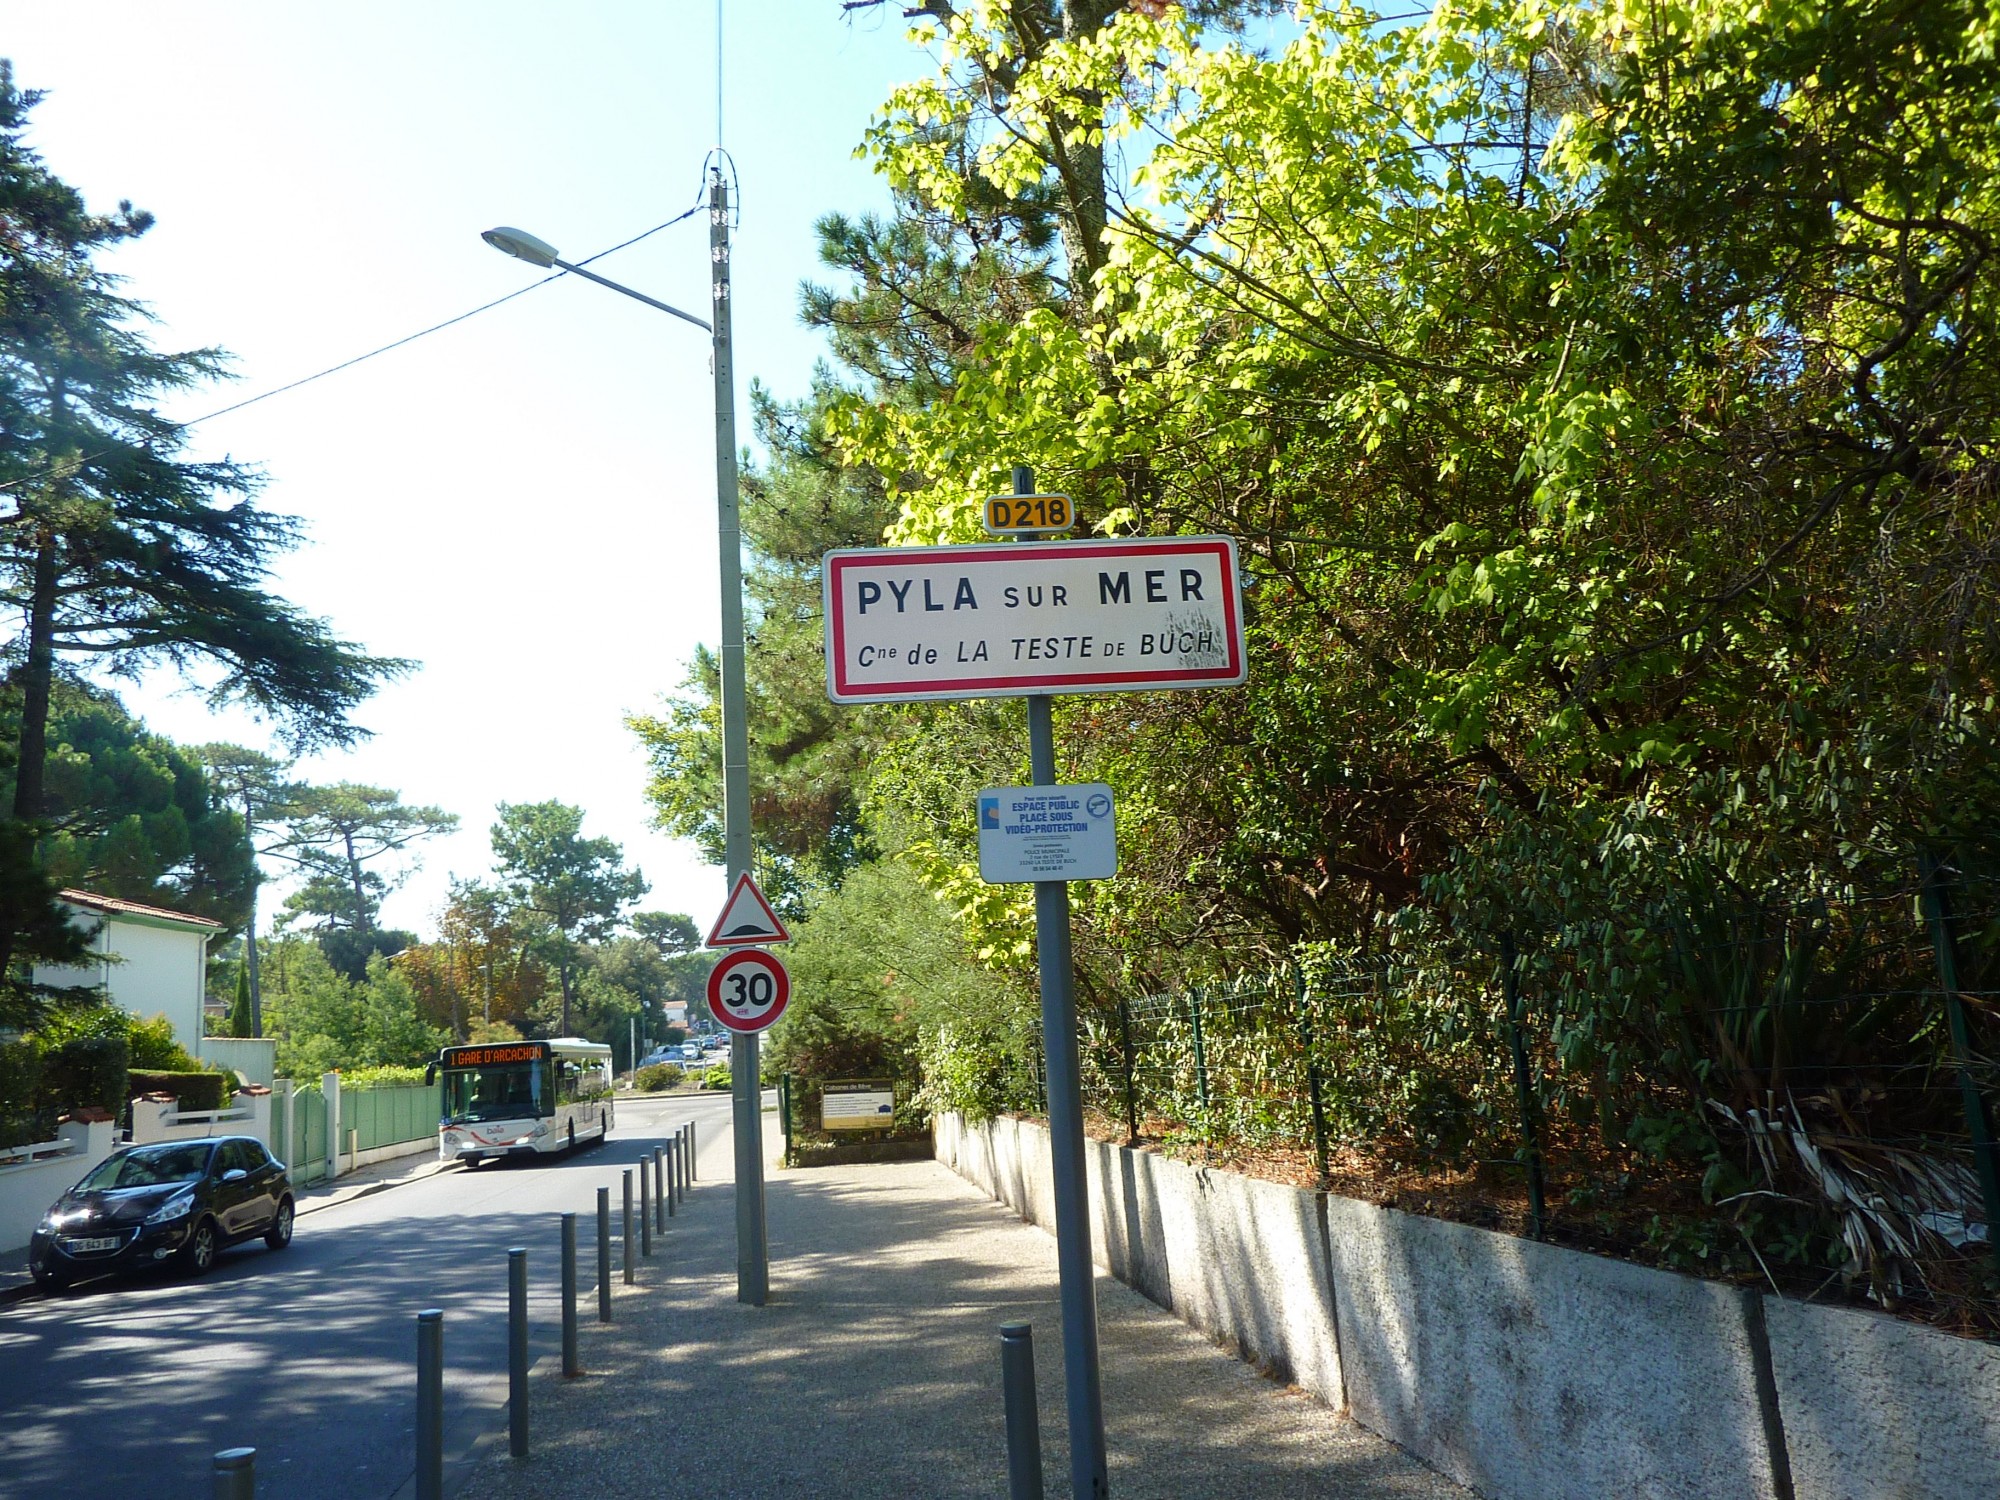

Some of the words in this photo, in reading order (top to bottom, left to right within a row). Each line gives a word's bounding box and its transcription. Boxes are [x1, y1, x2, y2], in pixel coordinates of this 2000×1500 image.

[993, 500, 1066, 527] D218
[858, 577, 978, 615] PYLA
[1004, 585, 1068, 608] SUR
[1099, 569, 1204, 605] MER
[858, 645, 897, 667] Cne
[908, 643, 937, 665] de
[957, 640, 989, 662] LA
[1011, 636, 1093, 660] TESTE
[1104, 642, 1125, 657] DE
[1140, 631, 1213, 656] BUCH
[1012, 802, 1046, 811] ESPACE
[1049, 801, 1080, 810] PUBLIC
[1020, 811, 1047, 822] PLACÉ
[1050, 812, 1073, 822] SOUS
[1005, 823, 1087, 834] VIDÉO-PROTECTION
[726, 973, 772, 1006] 30
[451, 1054, 455, 1066] 1
[458, 1051, 482, 1065] GARE
[484, 1046, 542, 1063] D'ARCACHON
